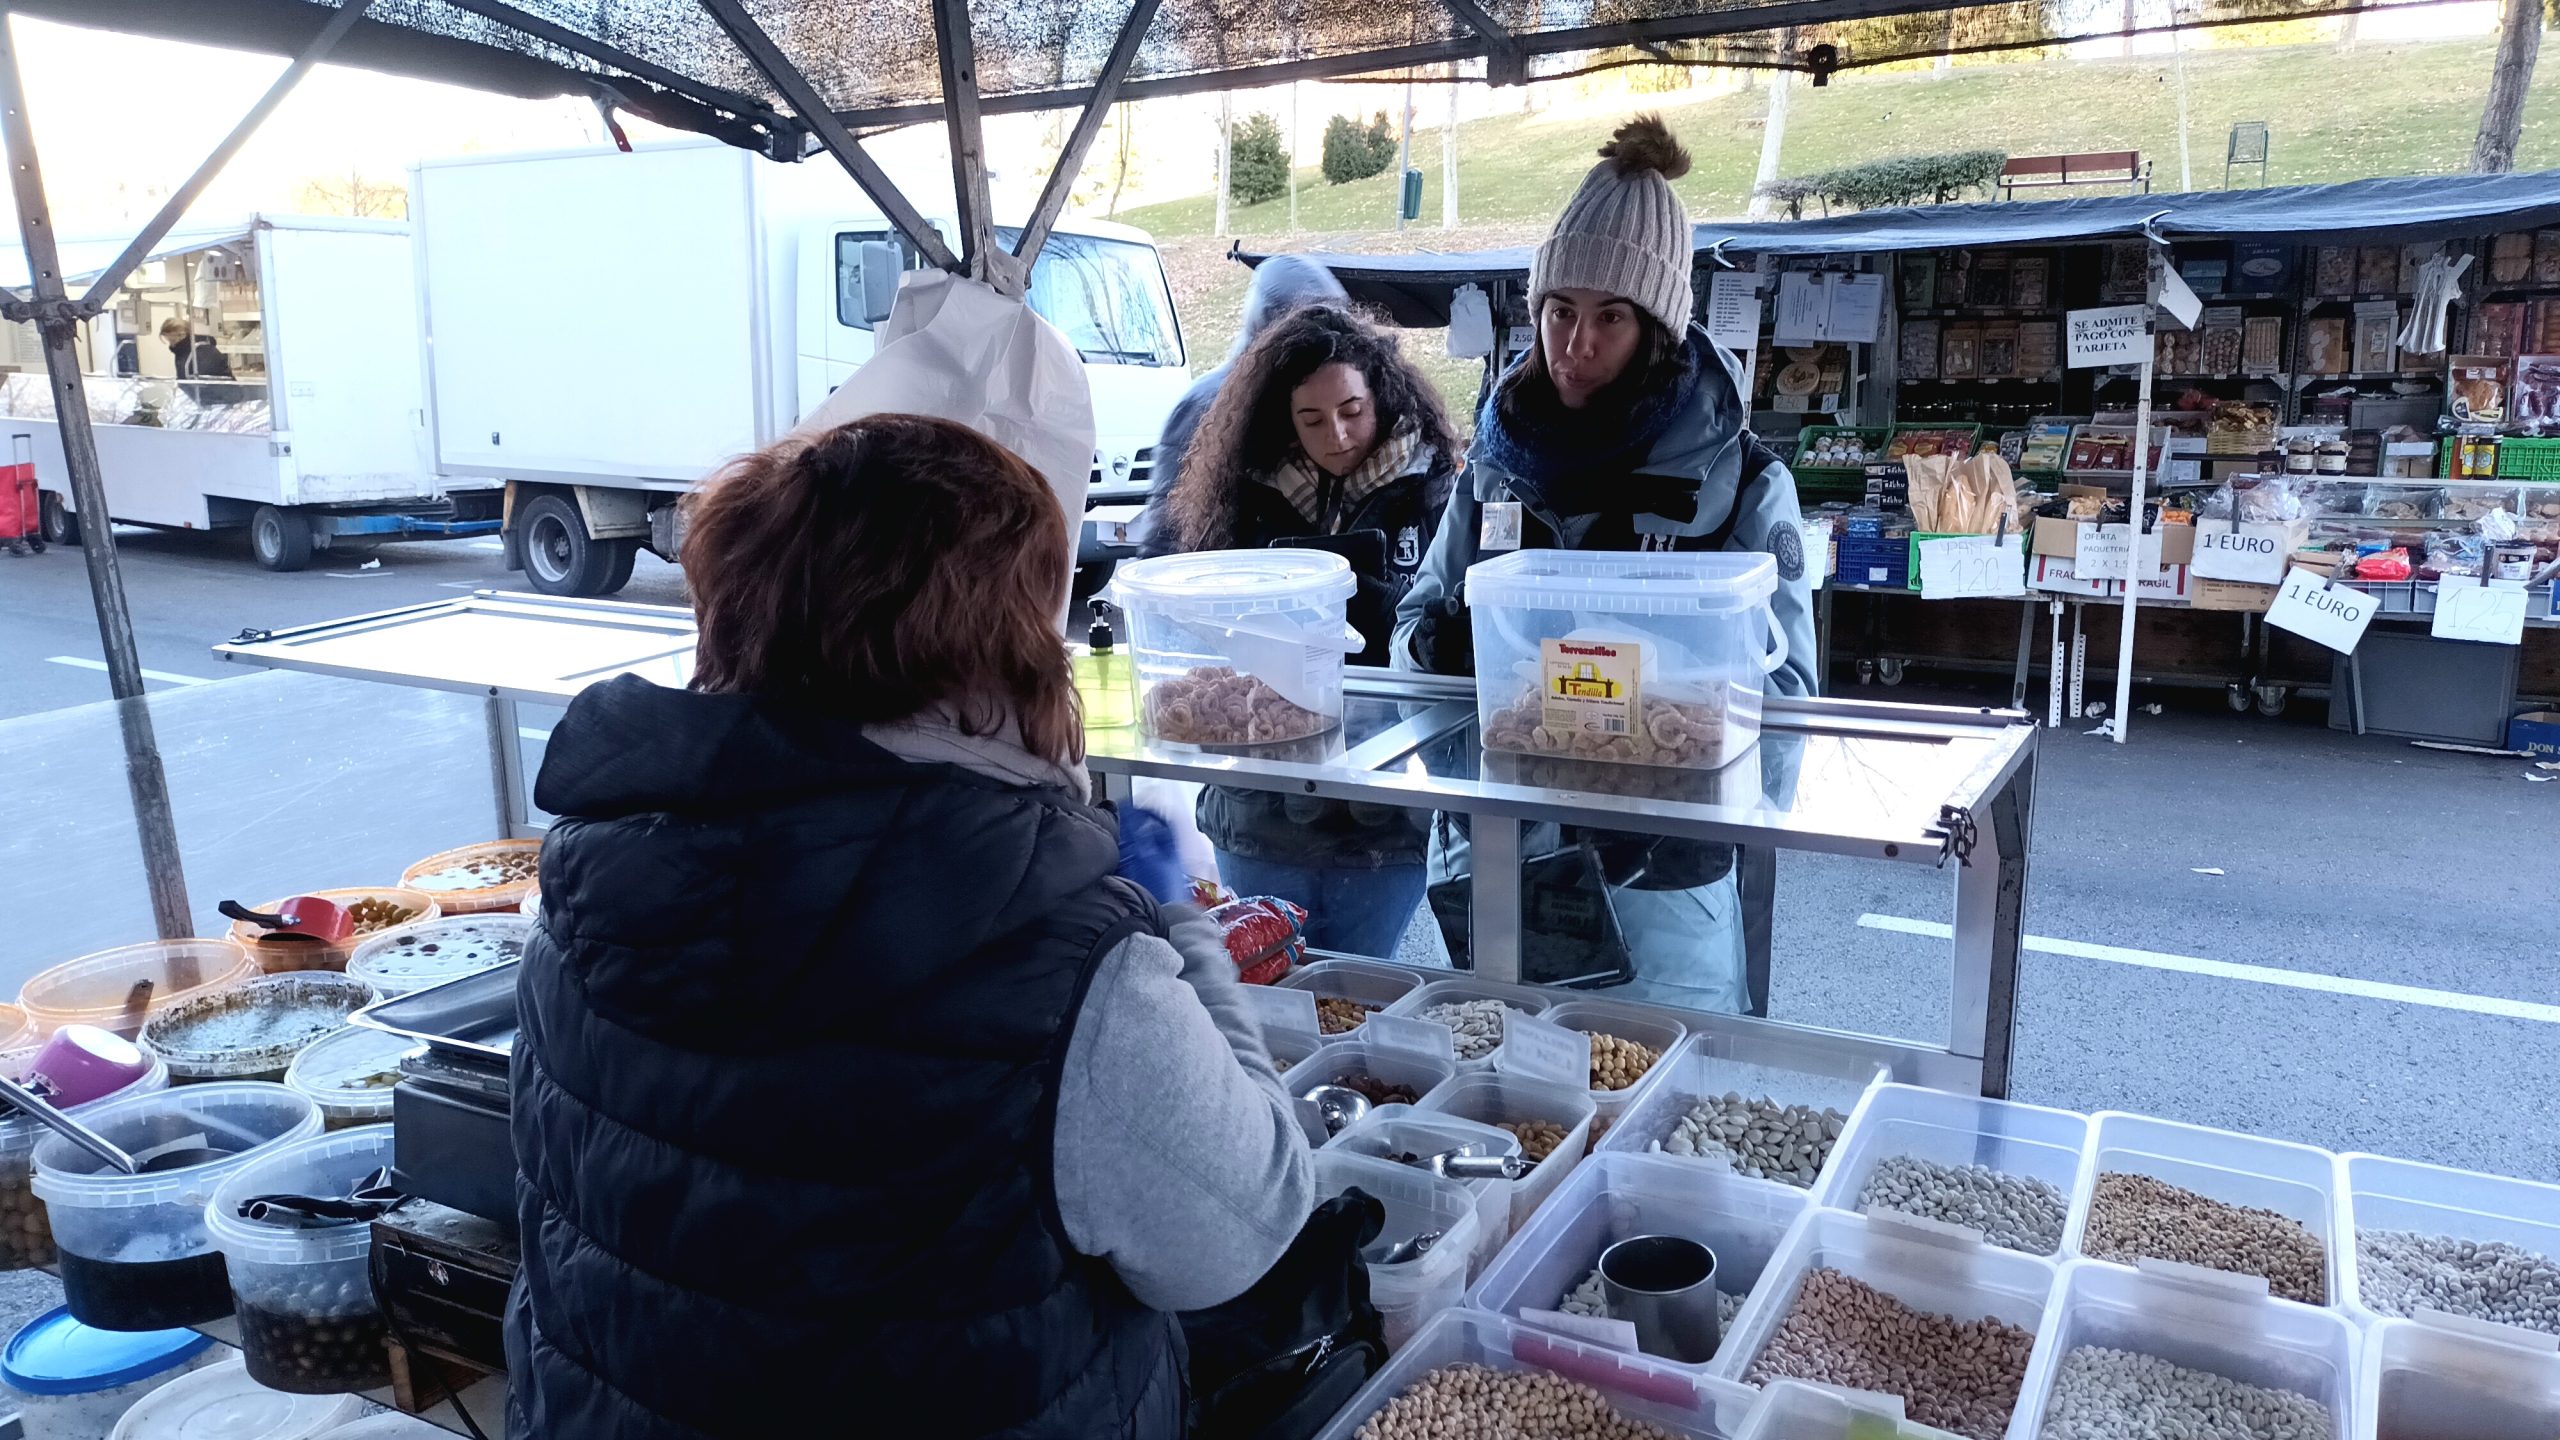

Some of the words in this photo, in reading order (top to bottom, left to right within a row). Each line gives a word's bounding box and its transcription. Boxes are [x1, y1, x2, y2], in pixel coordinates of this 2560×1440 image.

[2074, 320, 2088, 330] SE
[2091, 316, 2138, 328] ADMITE
[2075, 330, 2108, 341] PAGO
[2110, 328, 2135, 338] CON
[2075, 342, 2127, 353] TARJETA
[2084, 533, 2117, 541] OFERTA
[2203, 533, 2213, 549] 1
[2220, 534, 2275, 554] EURO
[2288, 584, 2300, 600] 1
[2304, 590, 2360, 622] EURO
[1568, 682, 1603, 697] Tendilla
[2528, 741, 2554, 754] DON
